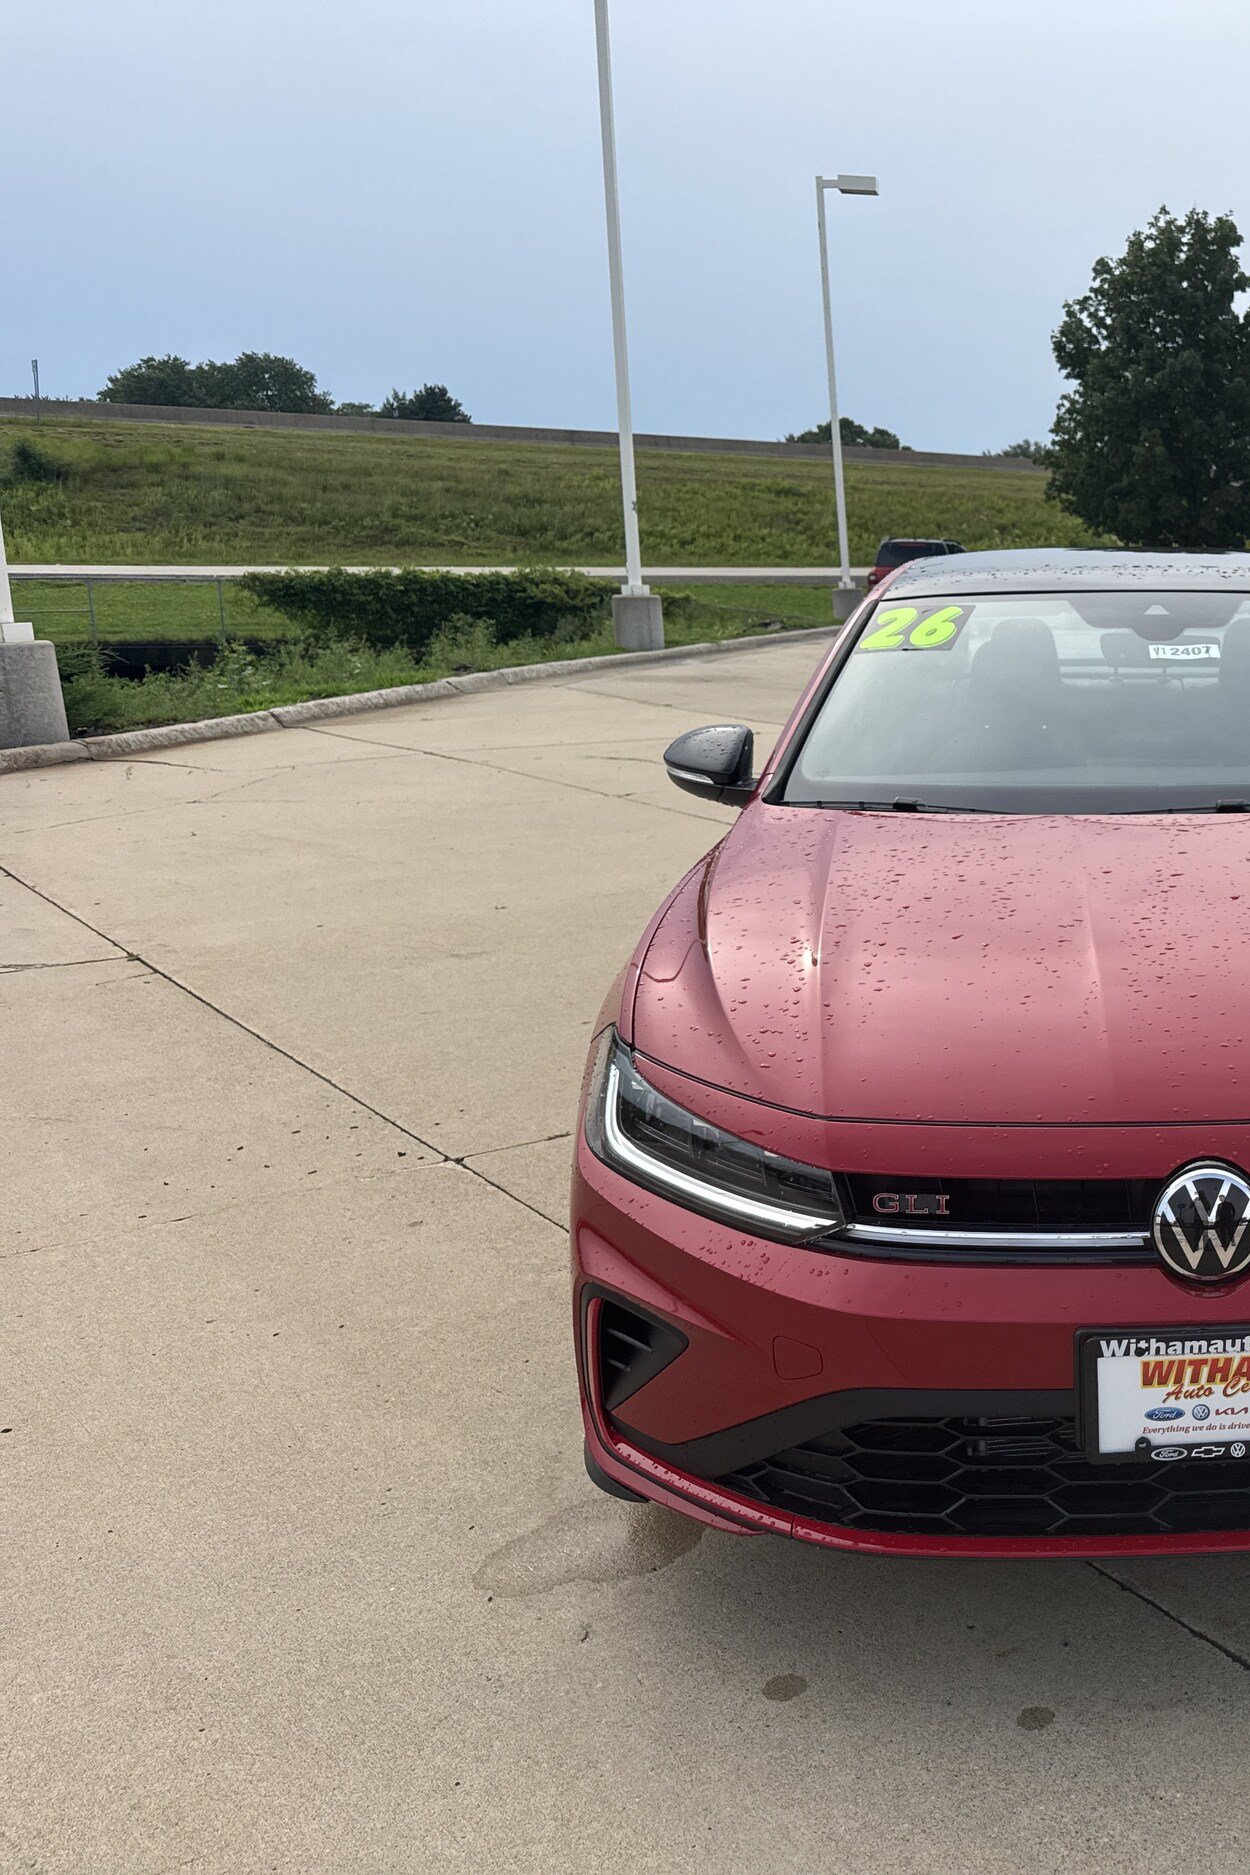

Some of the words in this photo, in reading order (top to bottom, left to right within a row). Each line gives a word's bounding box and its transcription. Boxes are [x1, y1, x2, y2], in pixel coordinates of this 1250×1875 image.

[859, 606, 964, 651] 26
[872, 1192, 950, 1215] GLI
[1162, 1383, 1214, 1404] Auto
[1142, 1424, 1191, 1435] Everything
[1205, 1423, 1217, 1431] do
[1218, 1422, 1227, 1430] is
